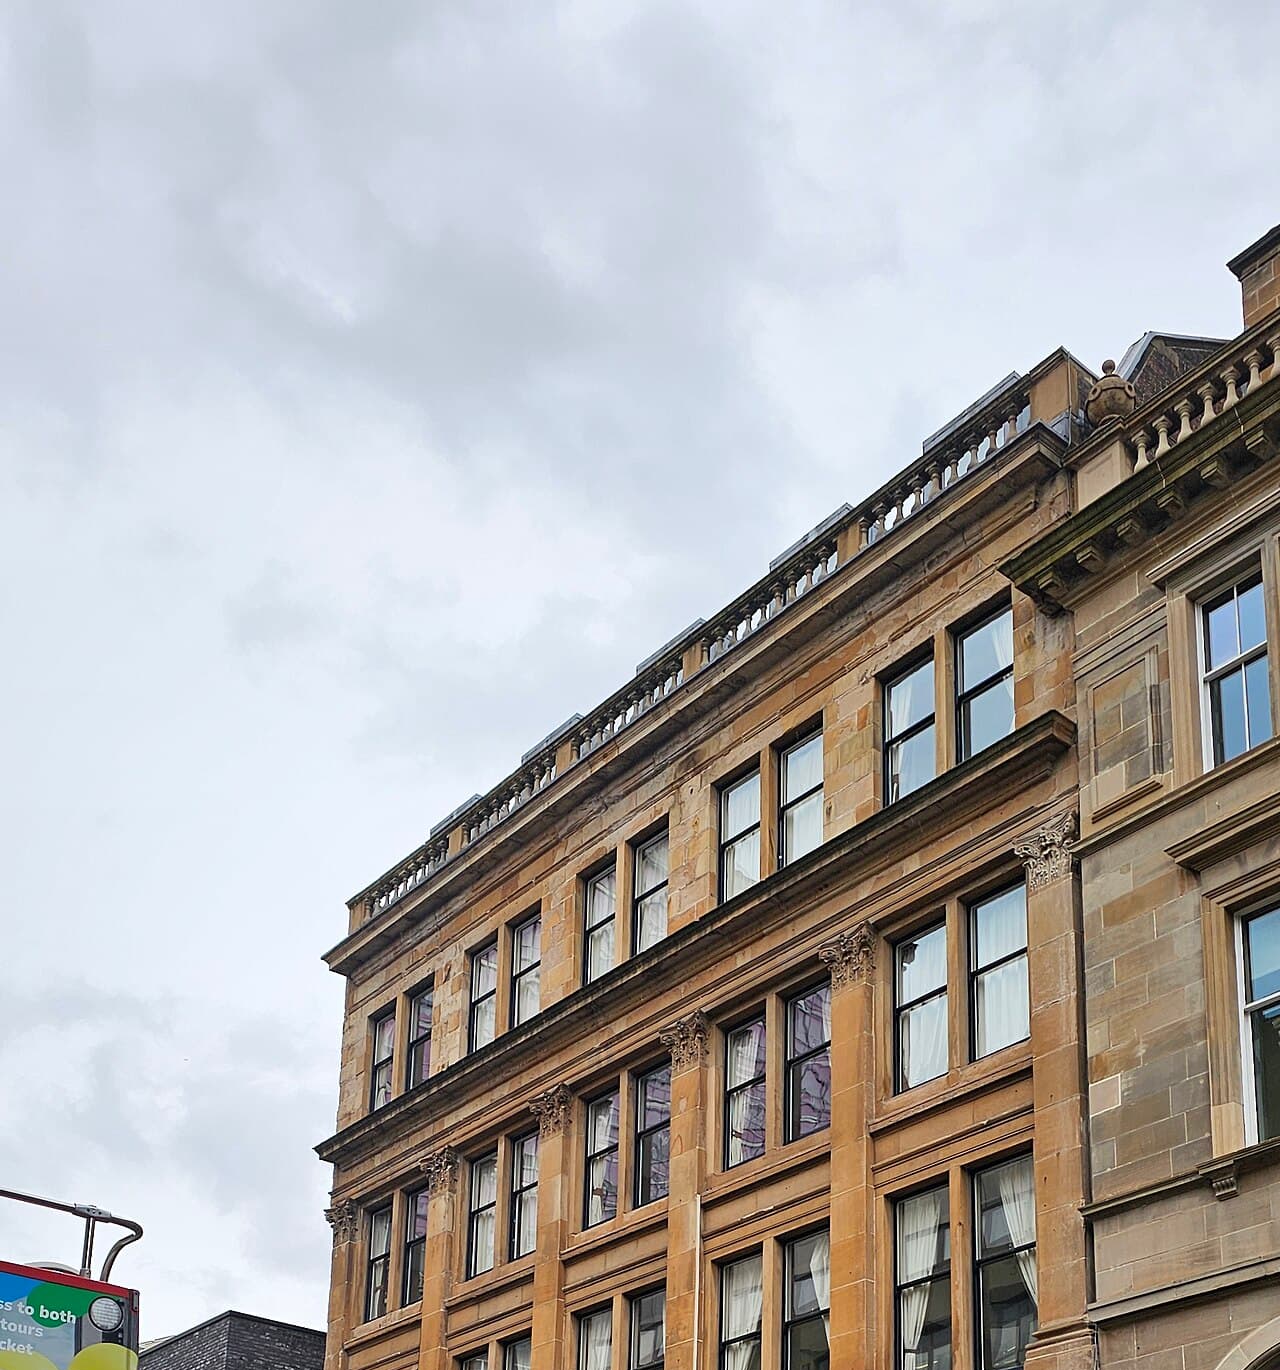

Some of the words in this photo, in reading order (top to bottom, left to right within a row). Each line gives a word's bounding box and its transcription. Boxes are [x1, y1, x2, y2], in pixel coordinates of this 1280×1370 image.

[17, 1301, 35, 1315] to
[39, 1304, 77, 1324] both
[0, 1318, 44, 1337] tours
